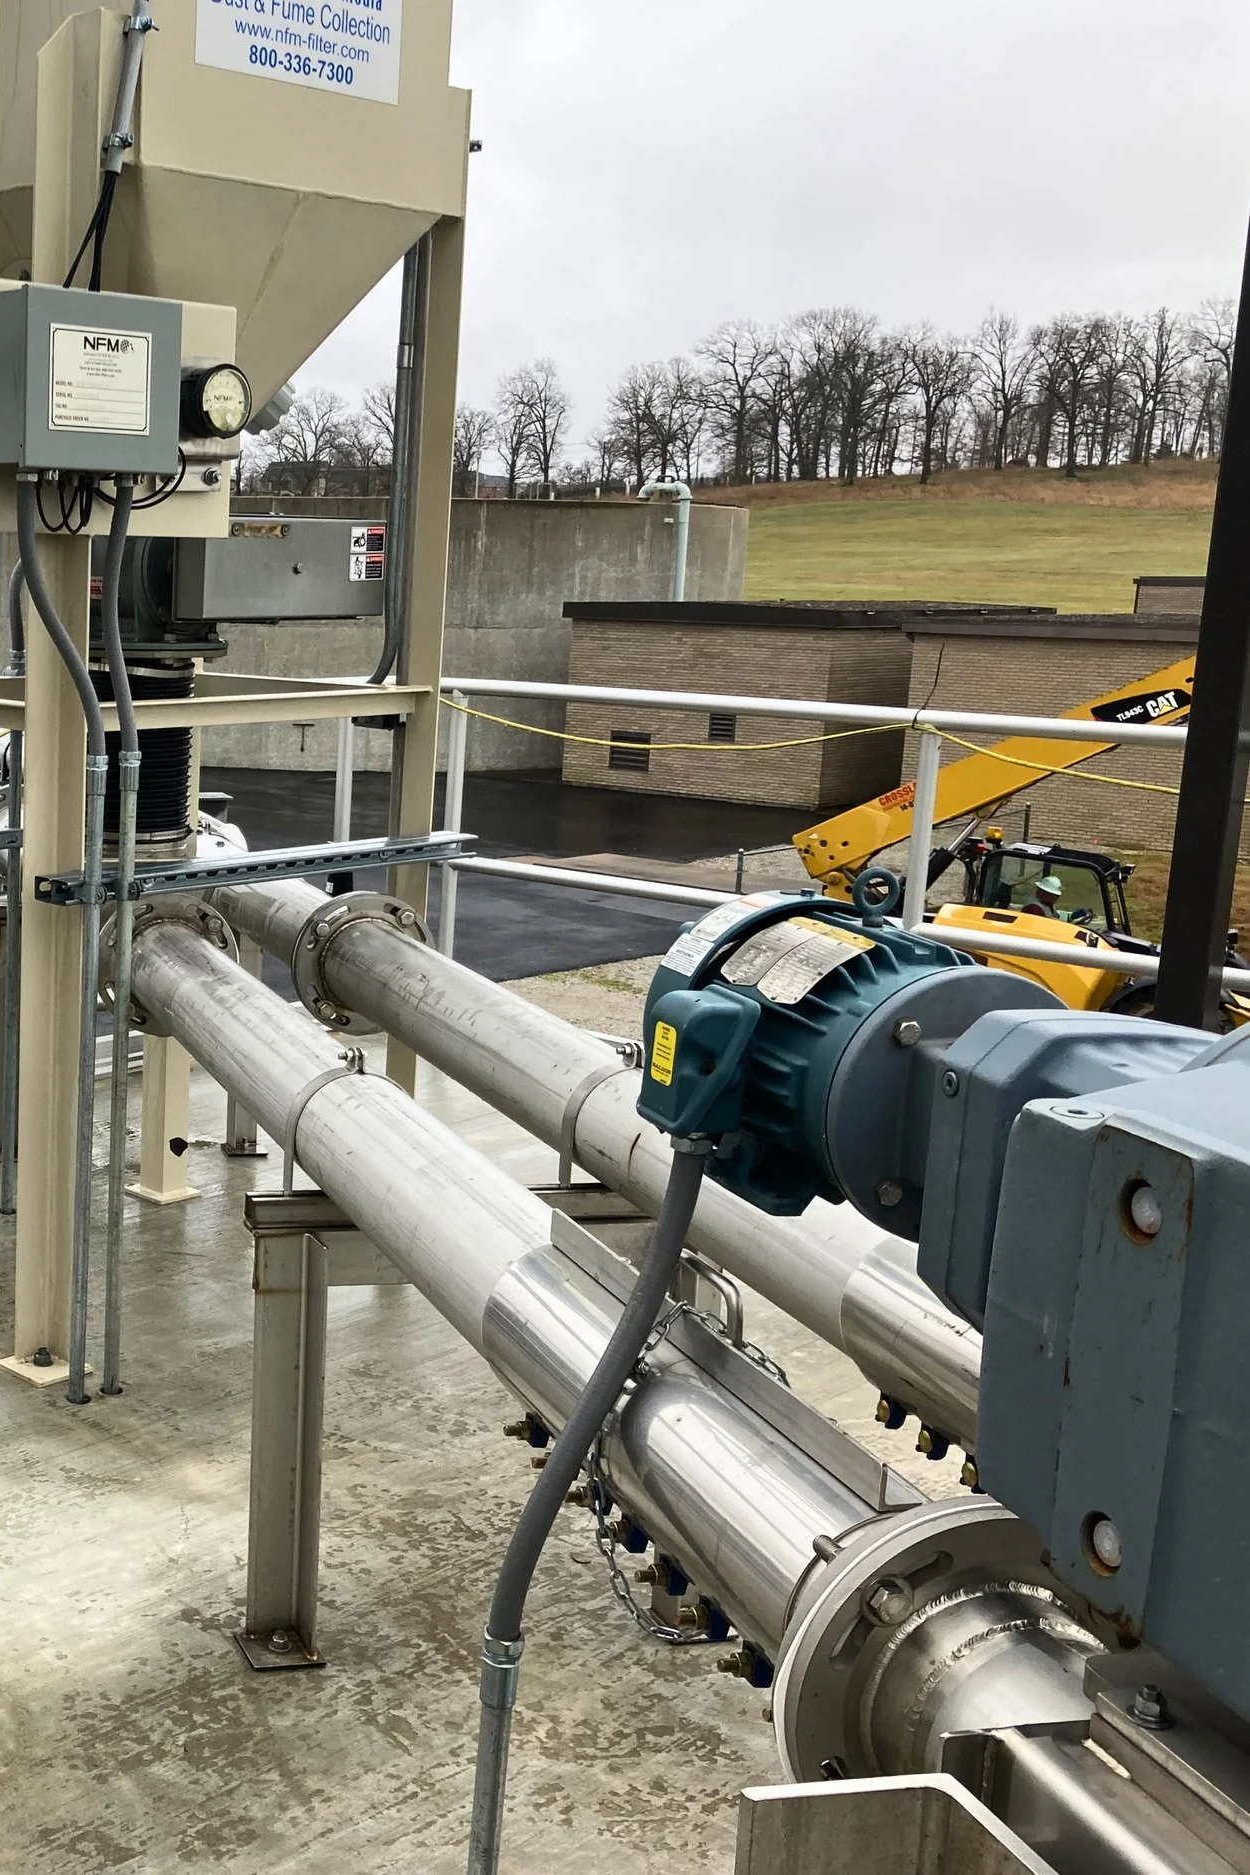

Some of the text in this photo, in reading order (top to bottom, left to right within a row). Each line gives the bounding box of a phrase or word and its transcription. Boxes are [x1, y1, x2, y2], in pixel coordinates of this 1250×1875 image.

[211, 0, 249, 10] ust
[254, 0, 265, 13] &
[271, 0, 315, 25] Fume
[320, 4, 391, 45] Collection
[234, 19, 370, 63] www.nfm-filter.com
[249, 44, 354, 85] 800-336-7300
[83, 336, 119, 352] NFM
[1116, 691, 1178, 721] TL943C CAT
[878, 782, 916, 806] CROSSL
